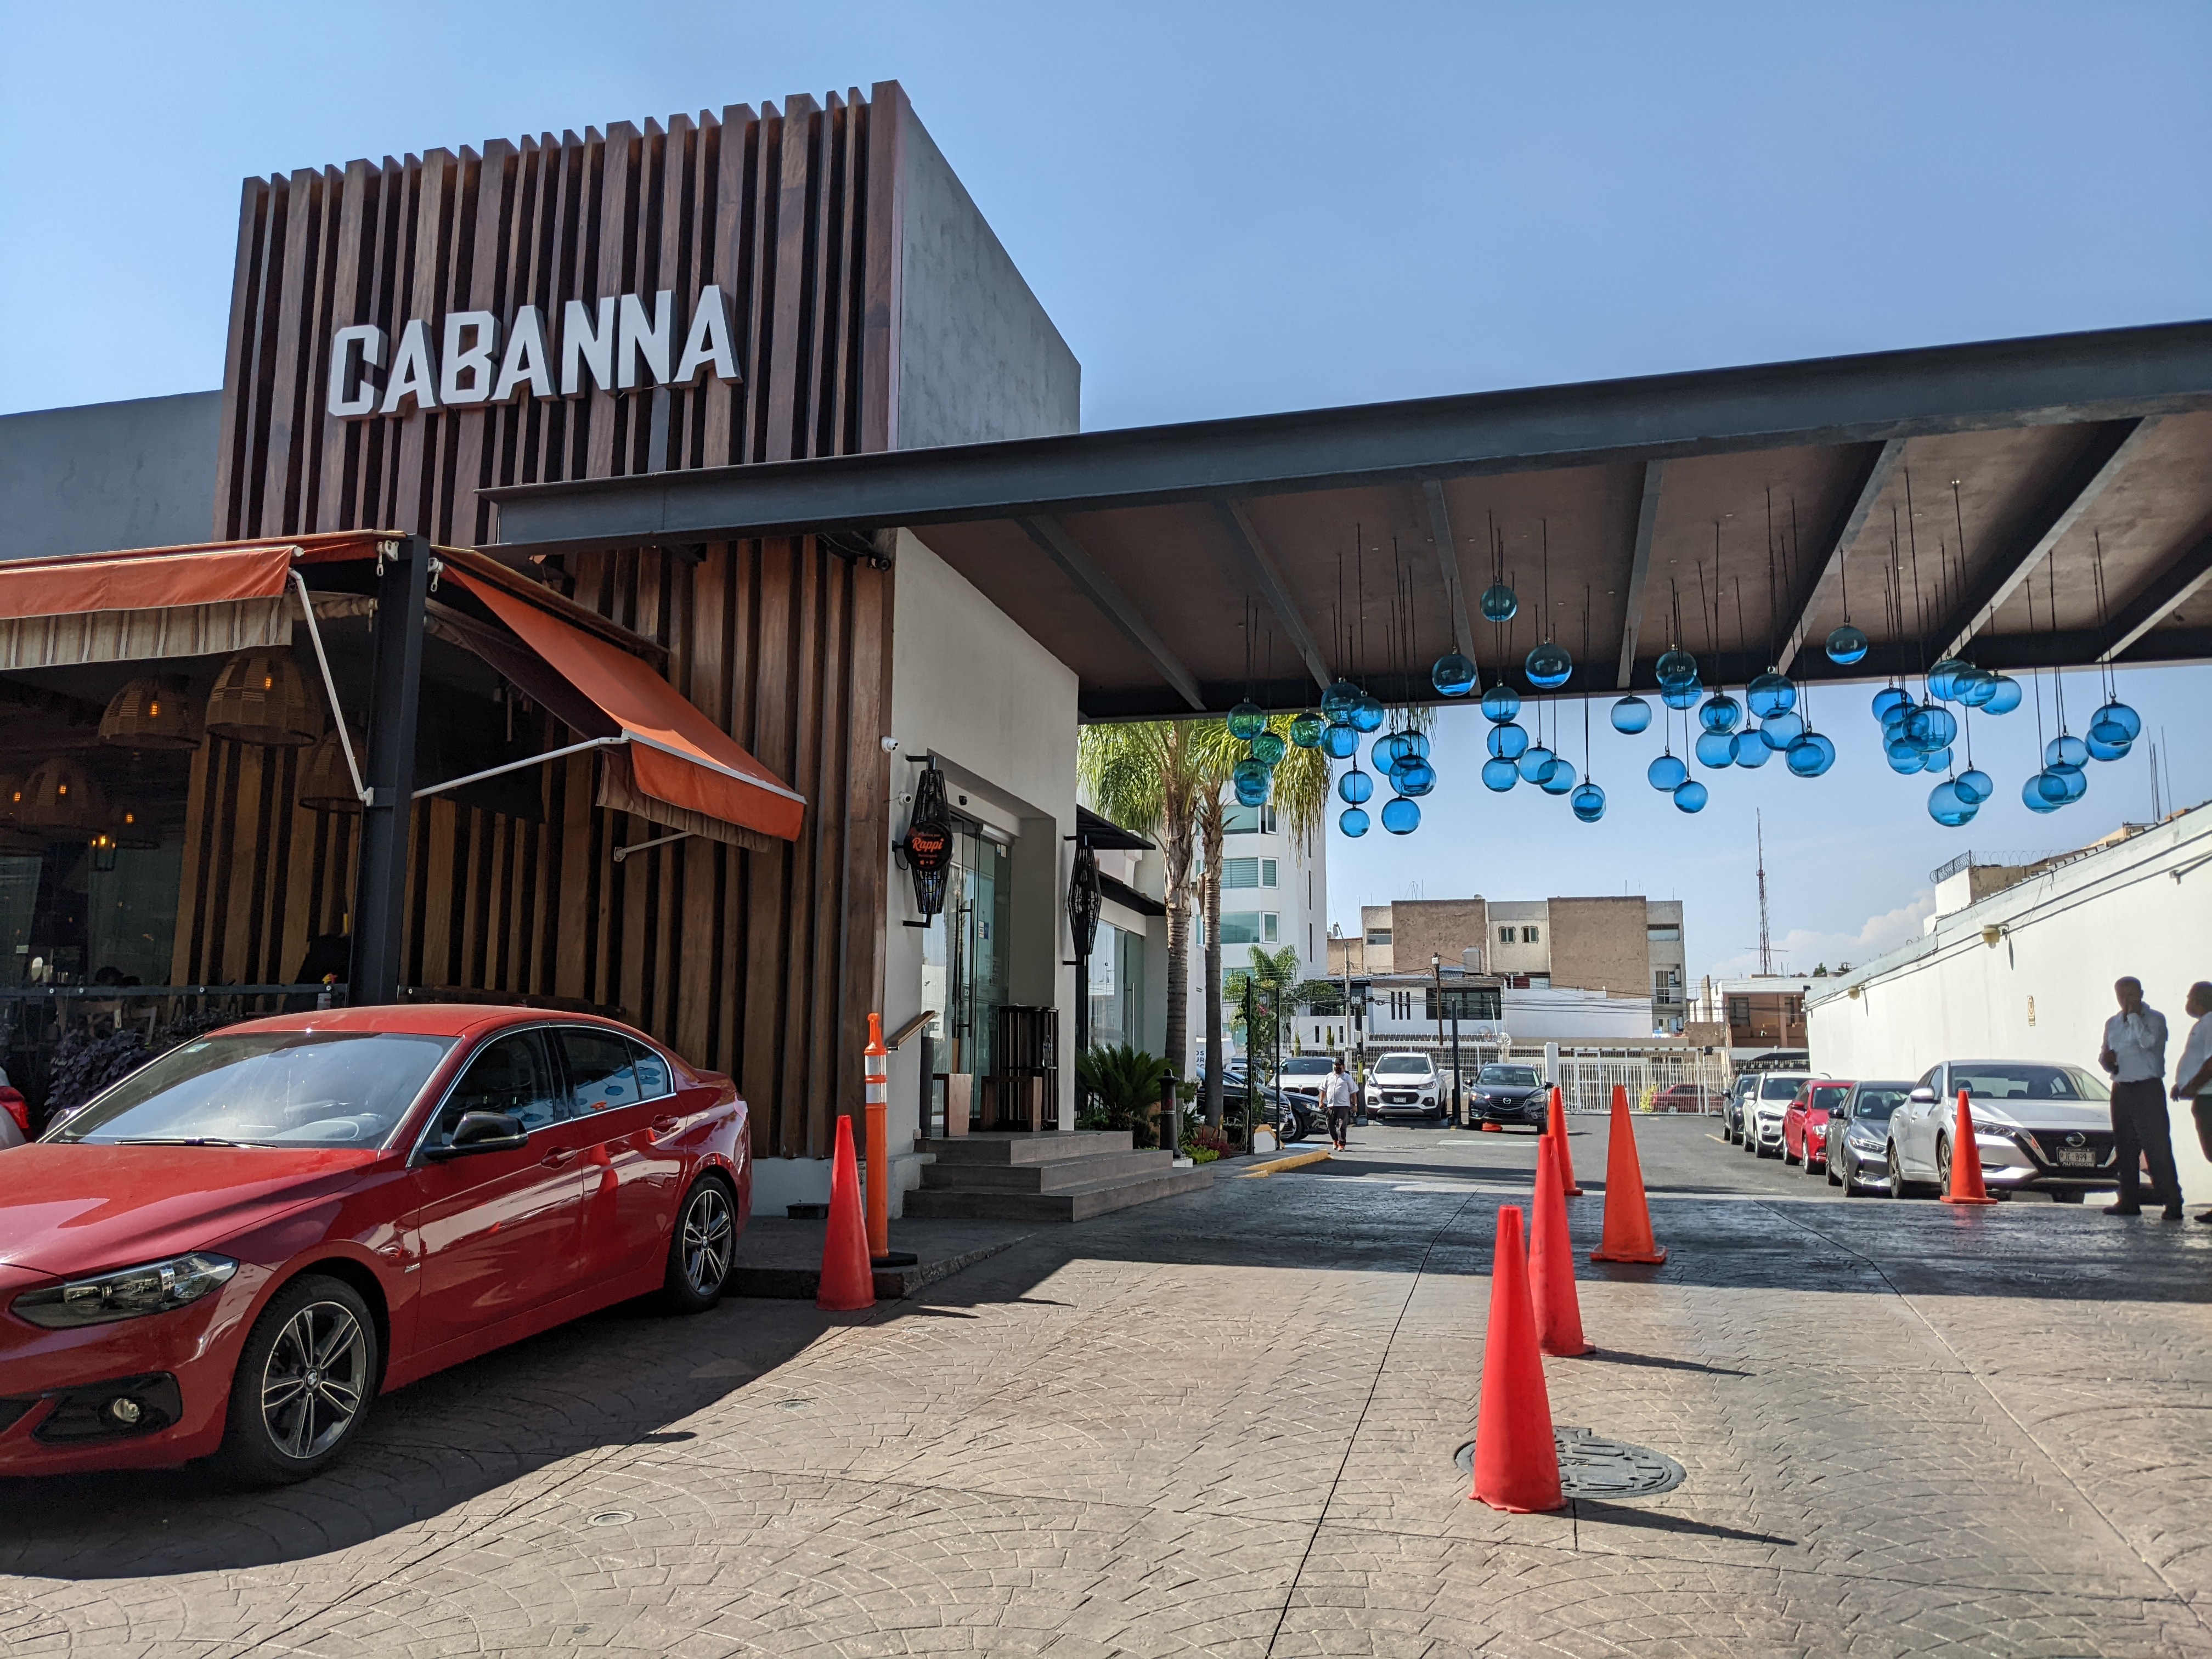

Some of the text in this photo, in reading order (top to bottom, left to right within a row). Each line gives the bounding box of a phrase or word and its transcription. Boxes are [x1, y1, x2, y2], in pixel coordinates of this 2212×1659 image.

[329, 285, 743, 420] CABANNA
[912, 838, 944, 853] Rappi
[1351, 996, 1361, 1005] 09
